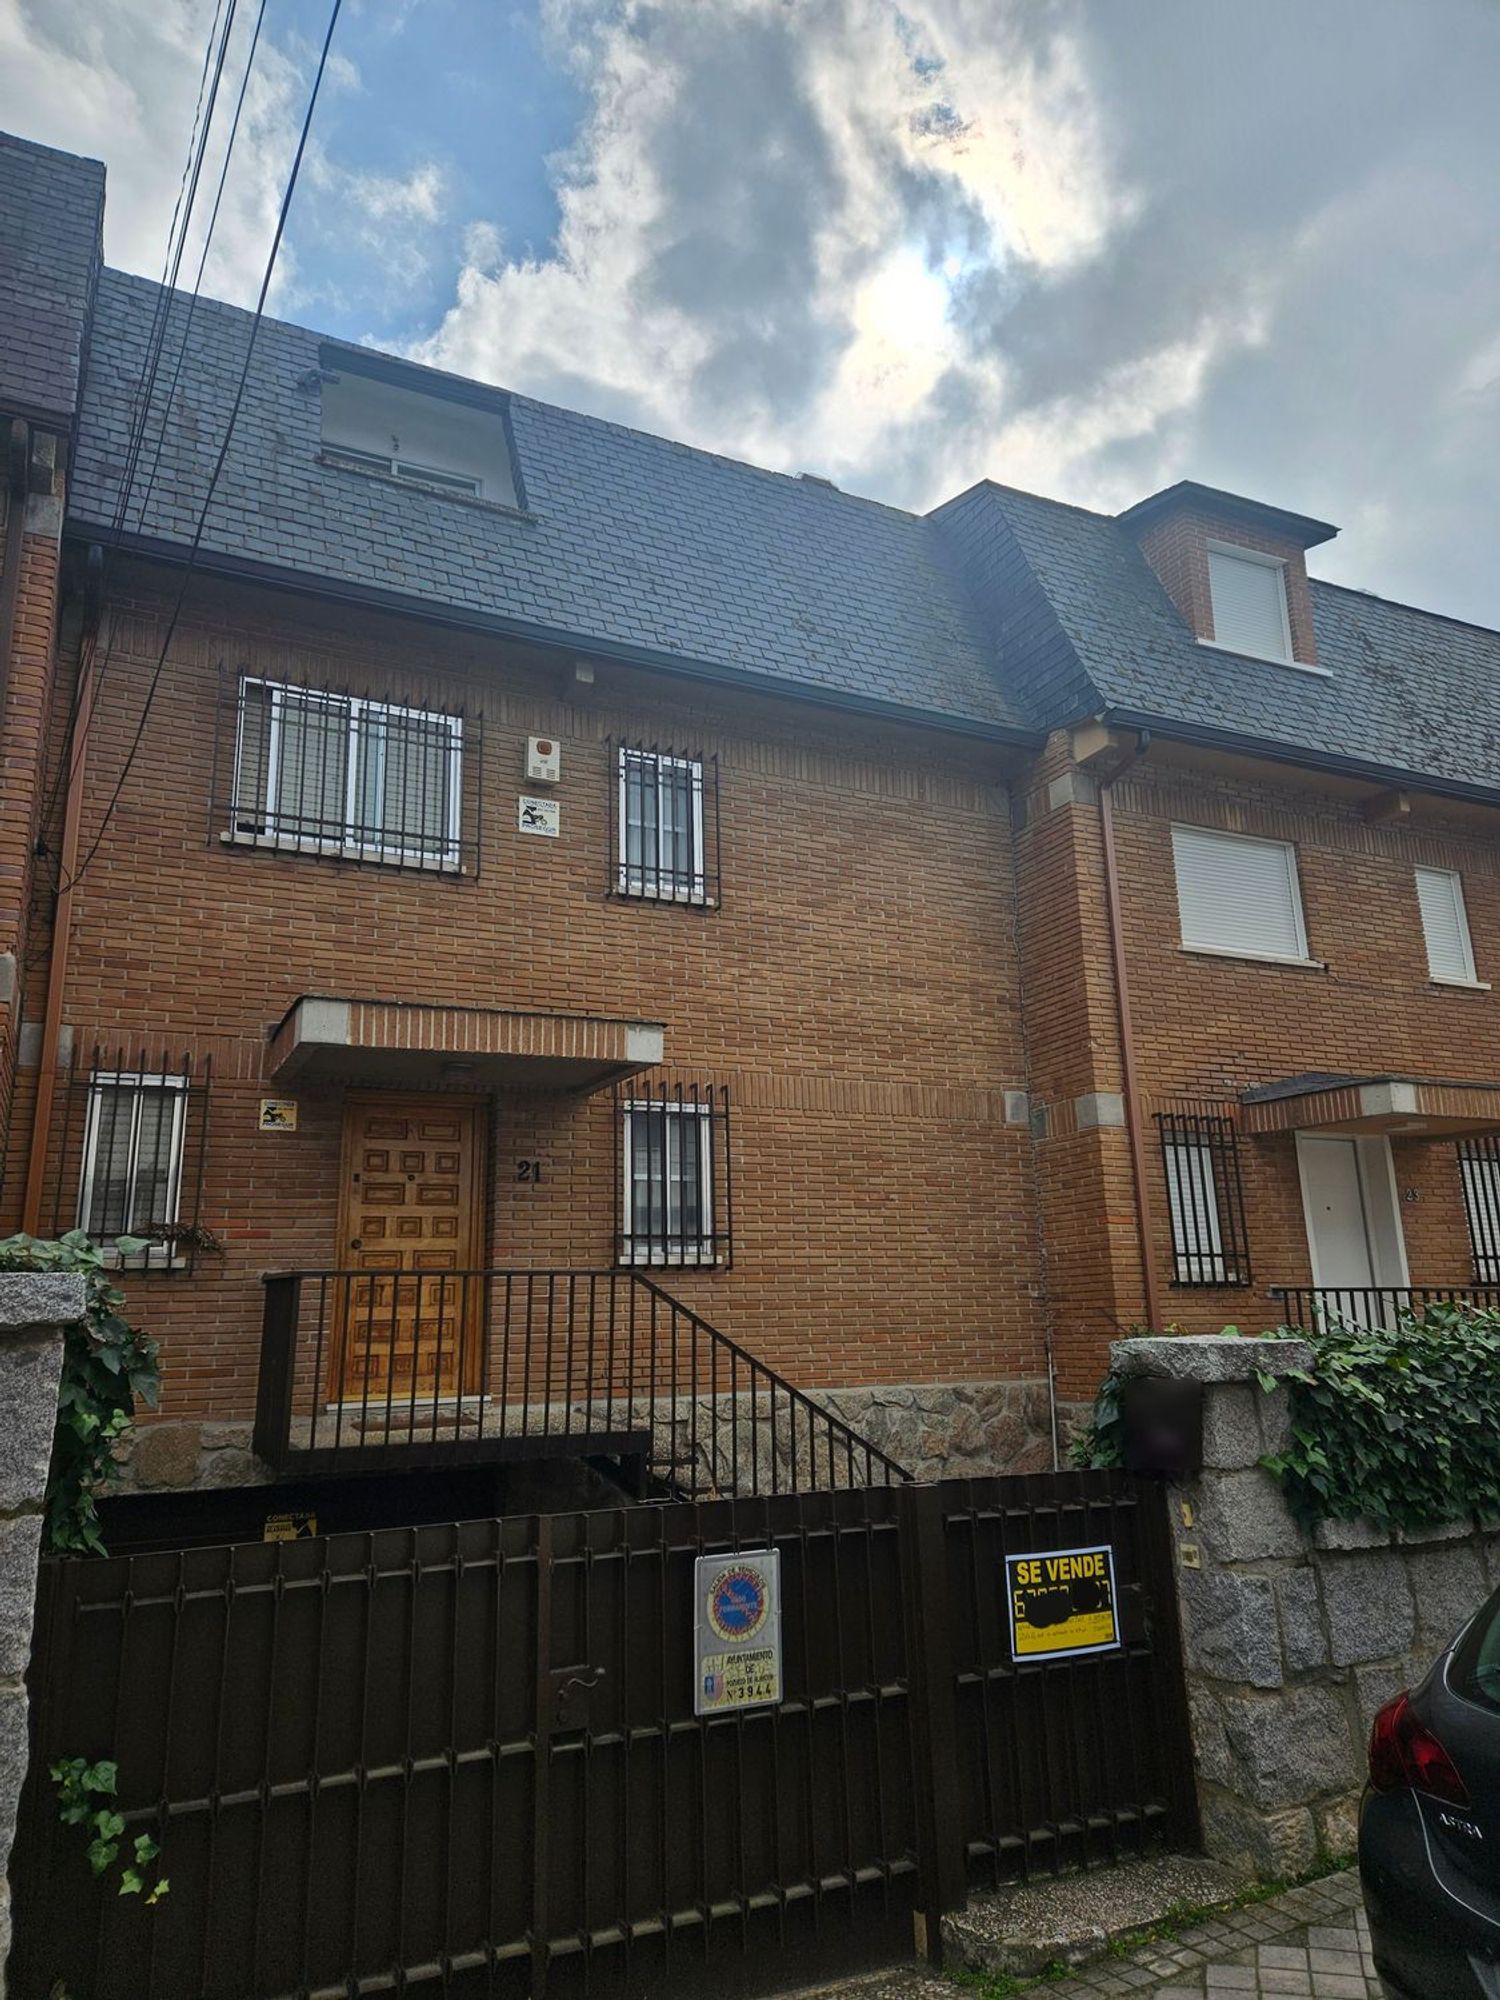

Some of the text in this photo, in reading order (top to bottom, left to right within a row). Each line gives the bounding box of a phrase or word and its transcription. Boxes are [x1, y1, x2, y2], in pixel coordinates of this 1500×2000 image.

[518, 1160, 540, 1182] 21
[1017, 1554, 1105, 1584] SE VENDE
[727, 1650, 773, 1664] AYUNTAMIENTO
[738, 1684, 771, 1698] 3944
[1440, 1813, 1483, 1839] ASTRA
